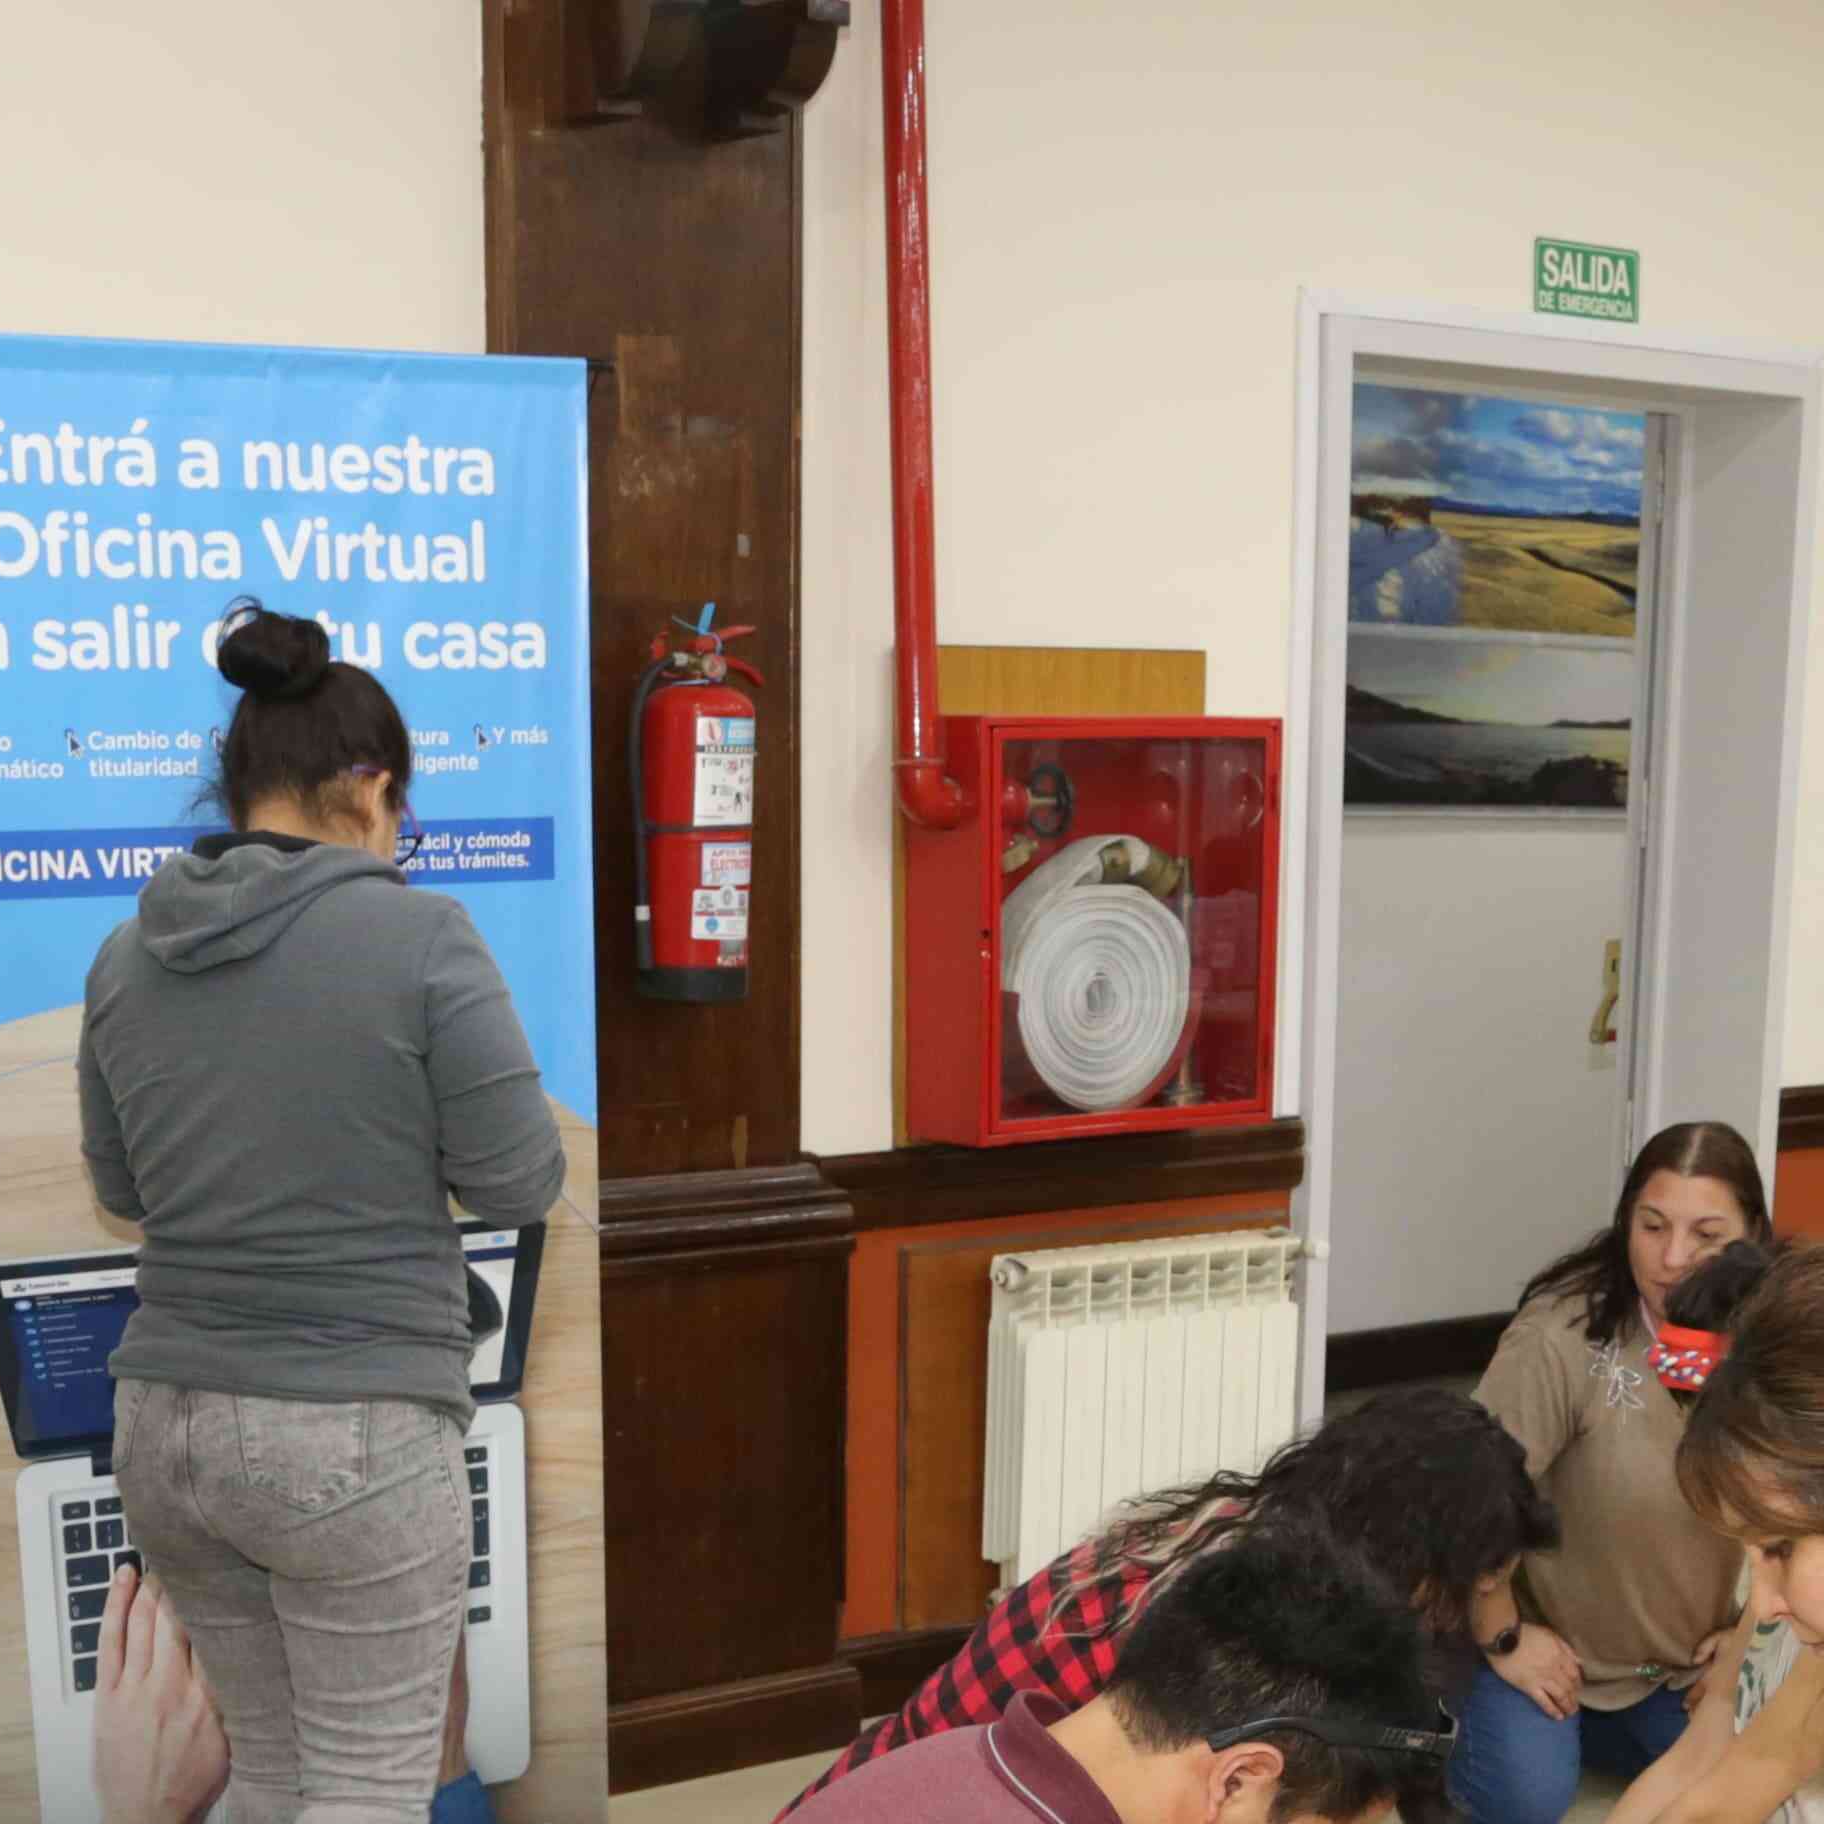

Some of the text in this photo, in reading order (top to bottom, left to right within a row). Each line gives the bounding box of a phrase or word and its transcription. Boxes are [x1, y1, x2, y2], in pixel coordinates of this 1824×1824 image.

[1542, 248, 1631, 296] SALIDA
[178, 439, 220, 489] a
[243, 435, 495, 496] nuestra
[261, 516, 485, 583] Virtual
[32, 604, 181, 670] salir
[403, 621, 546, 670] casa
[87, 730, 203, 751] Cambio de
[411, 727, 449, 745] tura
[492, 724, 549, 745] Y más
[89, 757, 198, 777] titularidad
[414, 753, 479, 774] ligente
[453, 836, 465, 856] y
[466, 830, 531, 849] cómoda
[96, 846, 184, 879] VIRT
[429, 853, 456, 870] tus
[459, 850, 529, 869] trámites.
